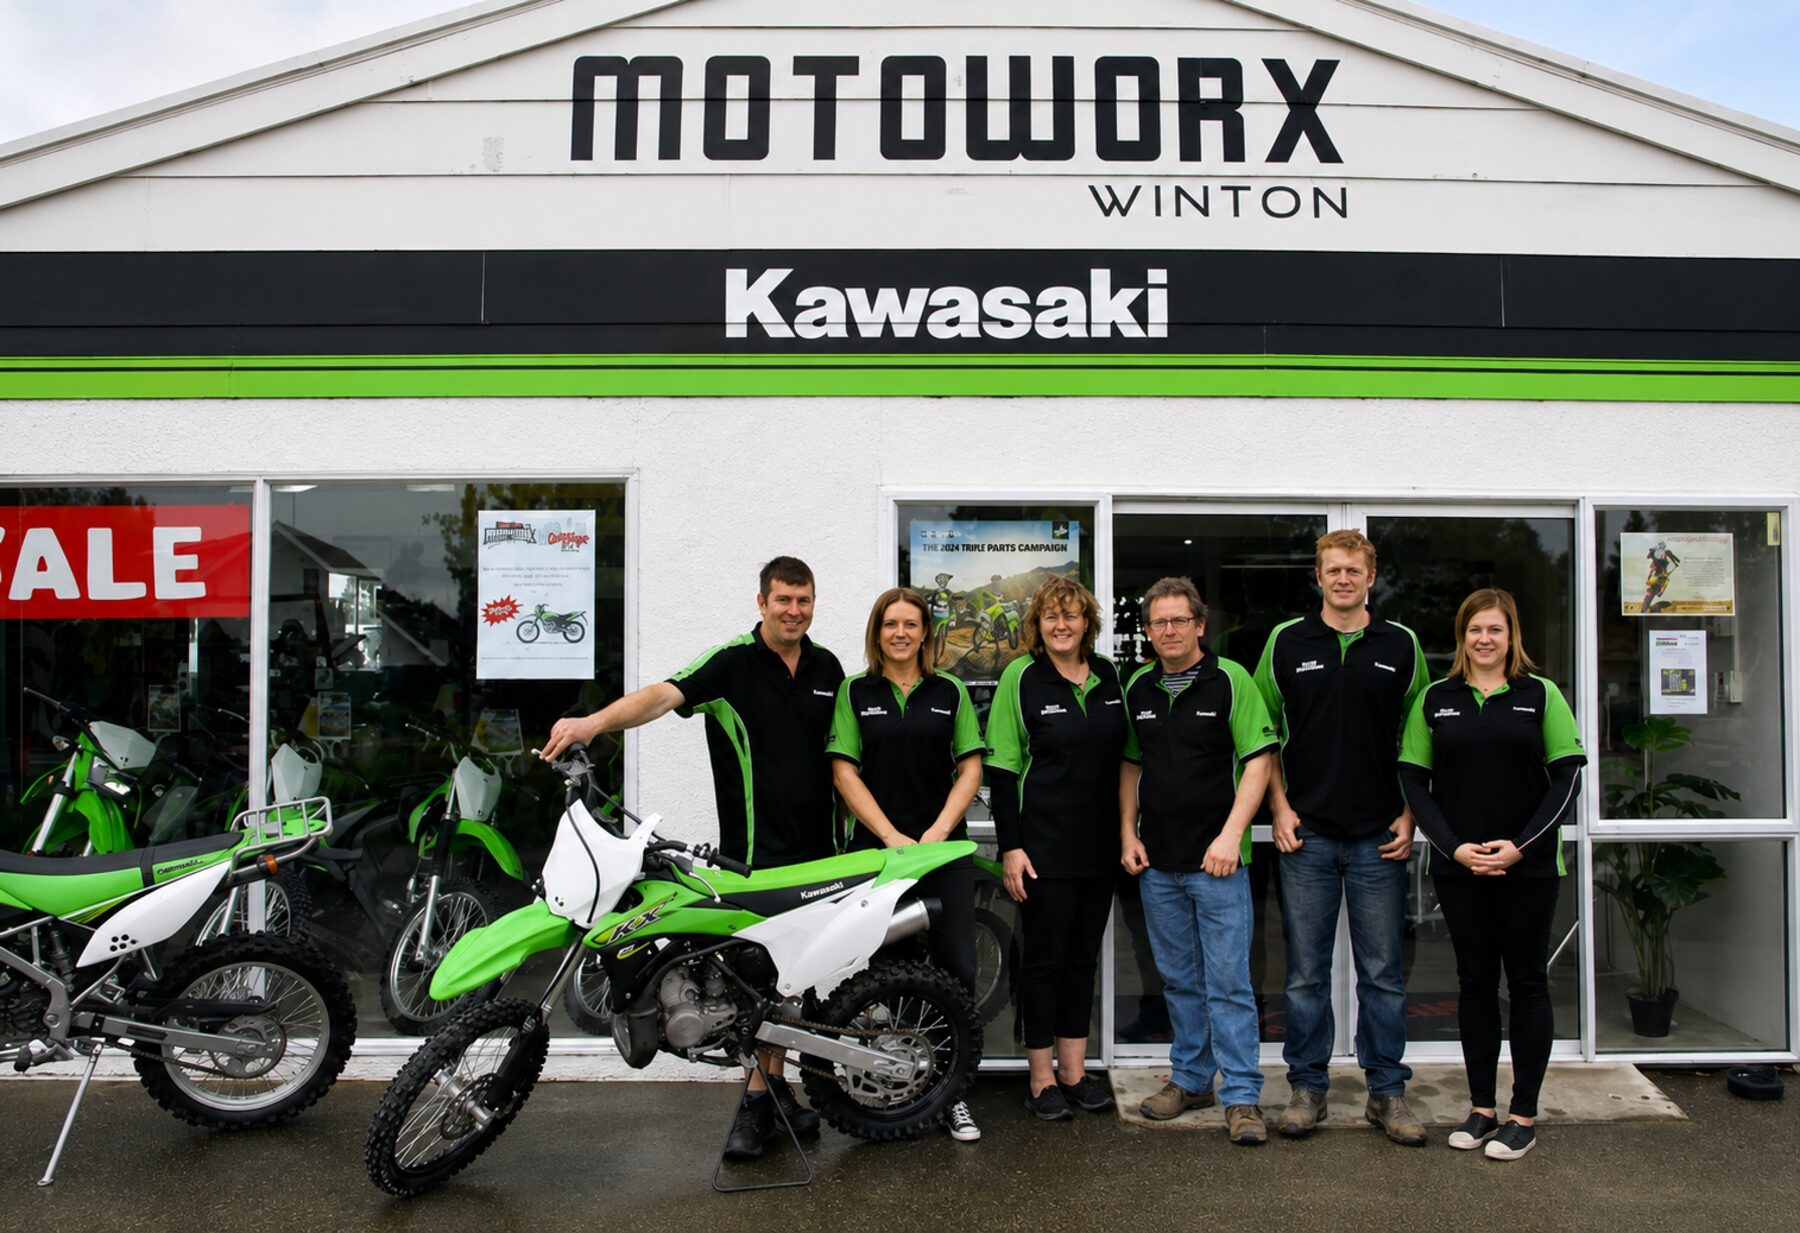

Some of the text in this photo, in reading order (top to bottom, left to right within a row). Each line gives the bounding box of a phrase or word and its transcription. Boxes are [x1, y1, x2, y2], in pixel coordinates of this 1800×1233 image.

[571, 56, 1344, 164] MOTOWORX
[1088, 185, 1348, 219] WINTON
[725, 268, 1168, 339] Kawasaki
[0, 526, 207, 601] ALE
[923, 543, 939, 552] THE
[940, 543, 959, 552] 2024
[987, 543, 1016, 552] PARTS
[1018, 543, 1068, 552] CAMPAIGN
[801, 880, 844, 900] Kawasaki
